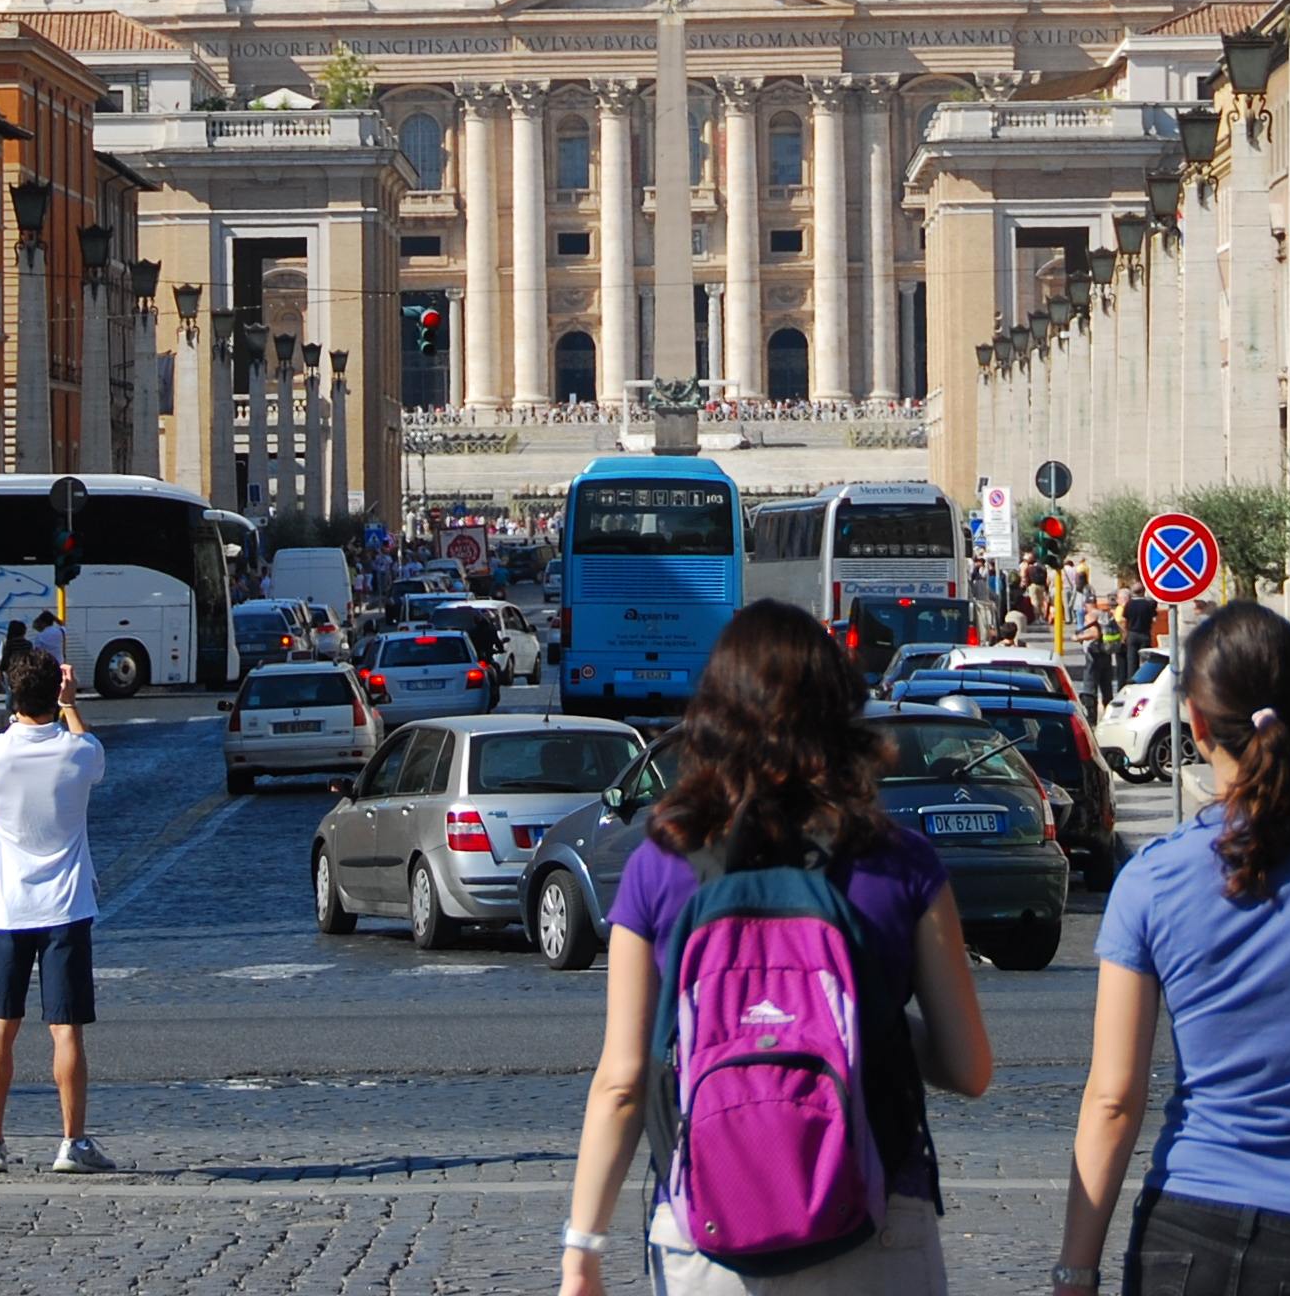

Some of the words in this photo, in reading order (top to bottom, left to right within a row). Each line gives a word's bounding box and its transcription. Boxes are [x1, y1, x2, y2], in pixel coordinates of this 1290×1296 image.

[228, 41, 334, 58] HONOREM
[340, 38, 443, 55] PRINCIPIS
[736, 31, 840, 49] ROMANVS
[706, 494, 724, 504] 103
[919, 583, 945, 594] Bus
[935, 816, 952, 832] DK
[956, 814, 996, 831] 621LB
